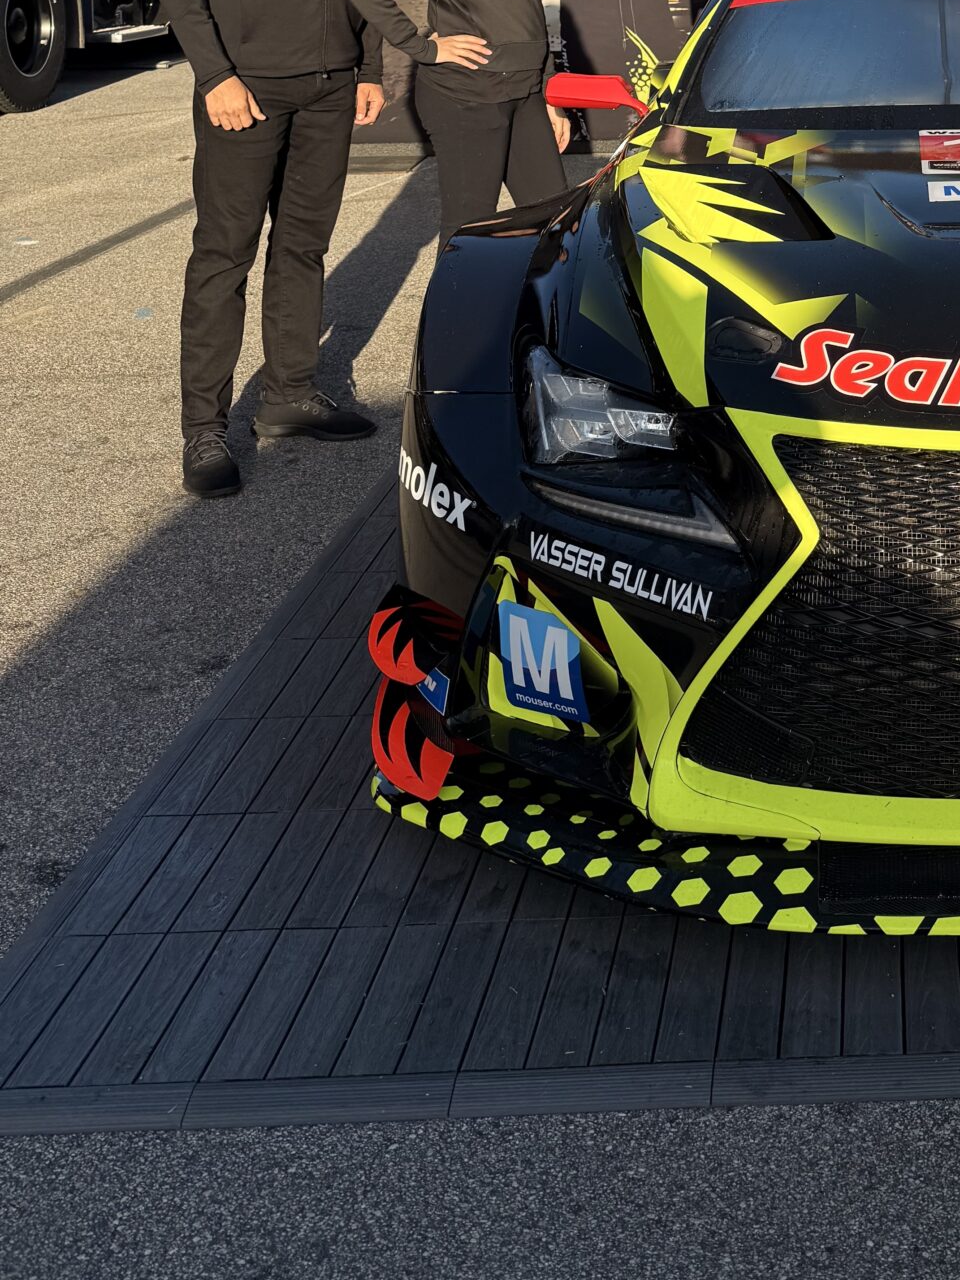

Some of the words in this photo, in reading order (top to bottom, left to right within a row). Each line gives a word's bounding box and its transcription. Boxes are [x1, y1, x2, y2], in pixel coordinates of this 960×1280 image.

[530, 530, 606, 583] VASSER
[608, 560, 713, 622] SULLIVAN
[509, 614, 574, 701] M
[515, 692, 578, 716] mouser.com
